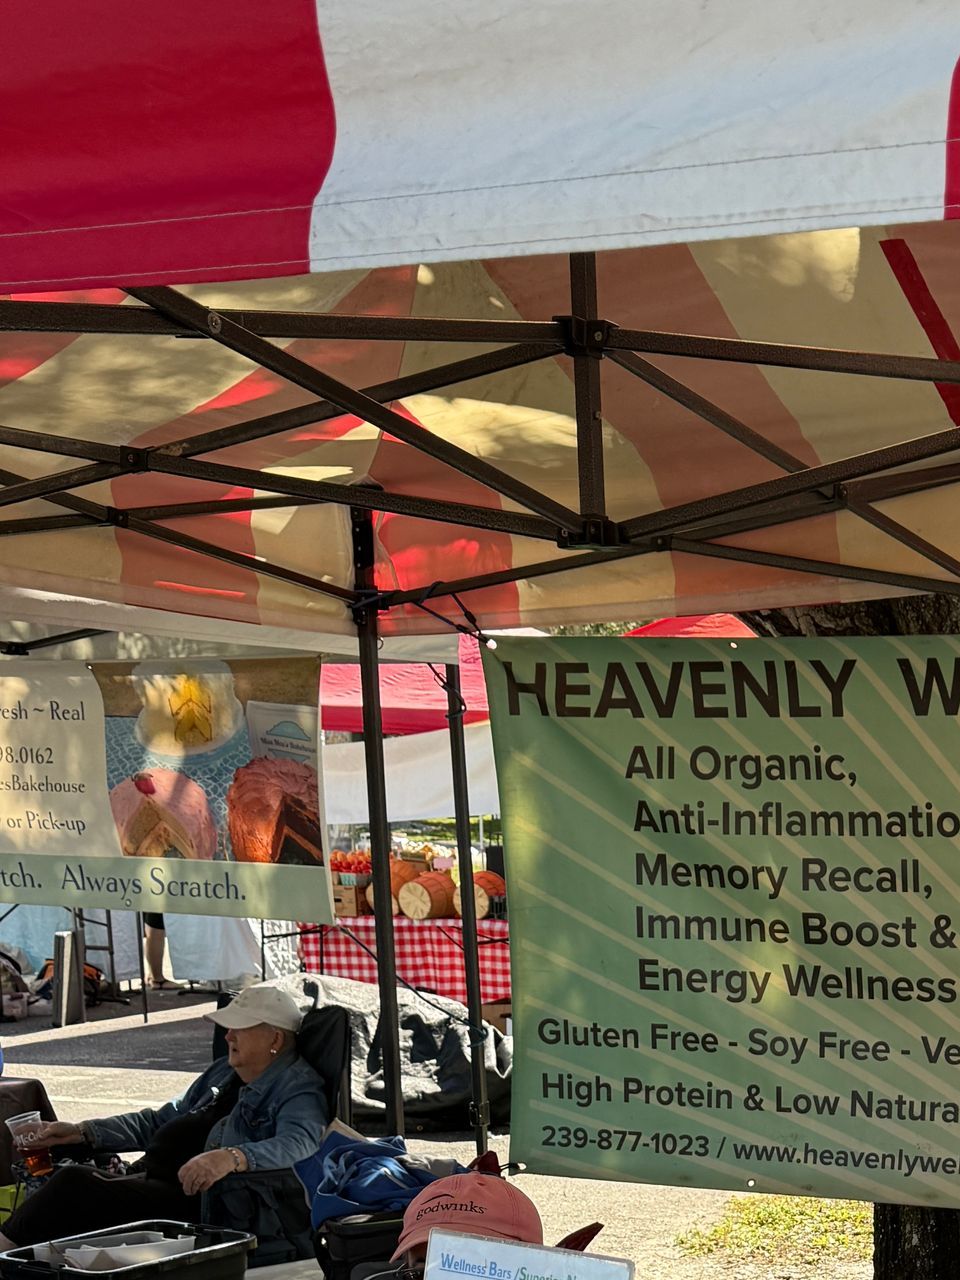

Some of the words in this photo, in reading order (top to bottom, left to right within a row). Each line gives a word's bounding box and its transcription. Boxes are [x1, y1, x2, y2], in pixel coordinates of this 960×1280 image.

[503, 659, 857, 718] HEAVENLY
[50, 700, 85, 720] Real
[625, 746, 675, 779] All
[690, 745, 857, 789] Organic,
[6, 817, 22, 829] or
[26, 810, 86, 836] Pick-up
[61, 864, 142, 900] Always
[150, 867, 246, 900] Scratch.
[635, 852, 788, 899] Memory
[801, 857, 932, 899] Recall,
[636, 906, 789, 943] Immune
[802, 912, 917, 948] Boost
[929, 915, 957, 948] &
[638, 959, 771, 1003] Energy
[783, 964, 957, 1003] Wellness
[538, 1018, 639, 1048] Gluten
[650, 1023, 718, 1053] Free
[748, 1028, 808, 1064] Soy
[819, 1031, 890, 1062] Free
[542, 1073, 612, 1107] High
[623, 1077, 733, 1109] Protein
[743, 1084, 764, 1111] &
[776, 1086, 840, 1116] Low
[541, 1125, 709, 1157] 239-877-1023
[416, 1201, 486, 1221] godwinks
[440, 1253, 486, 1275] Wellness
[489, 1261, 511, 1279] Bars
